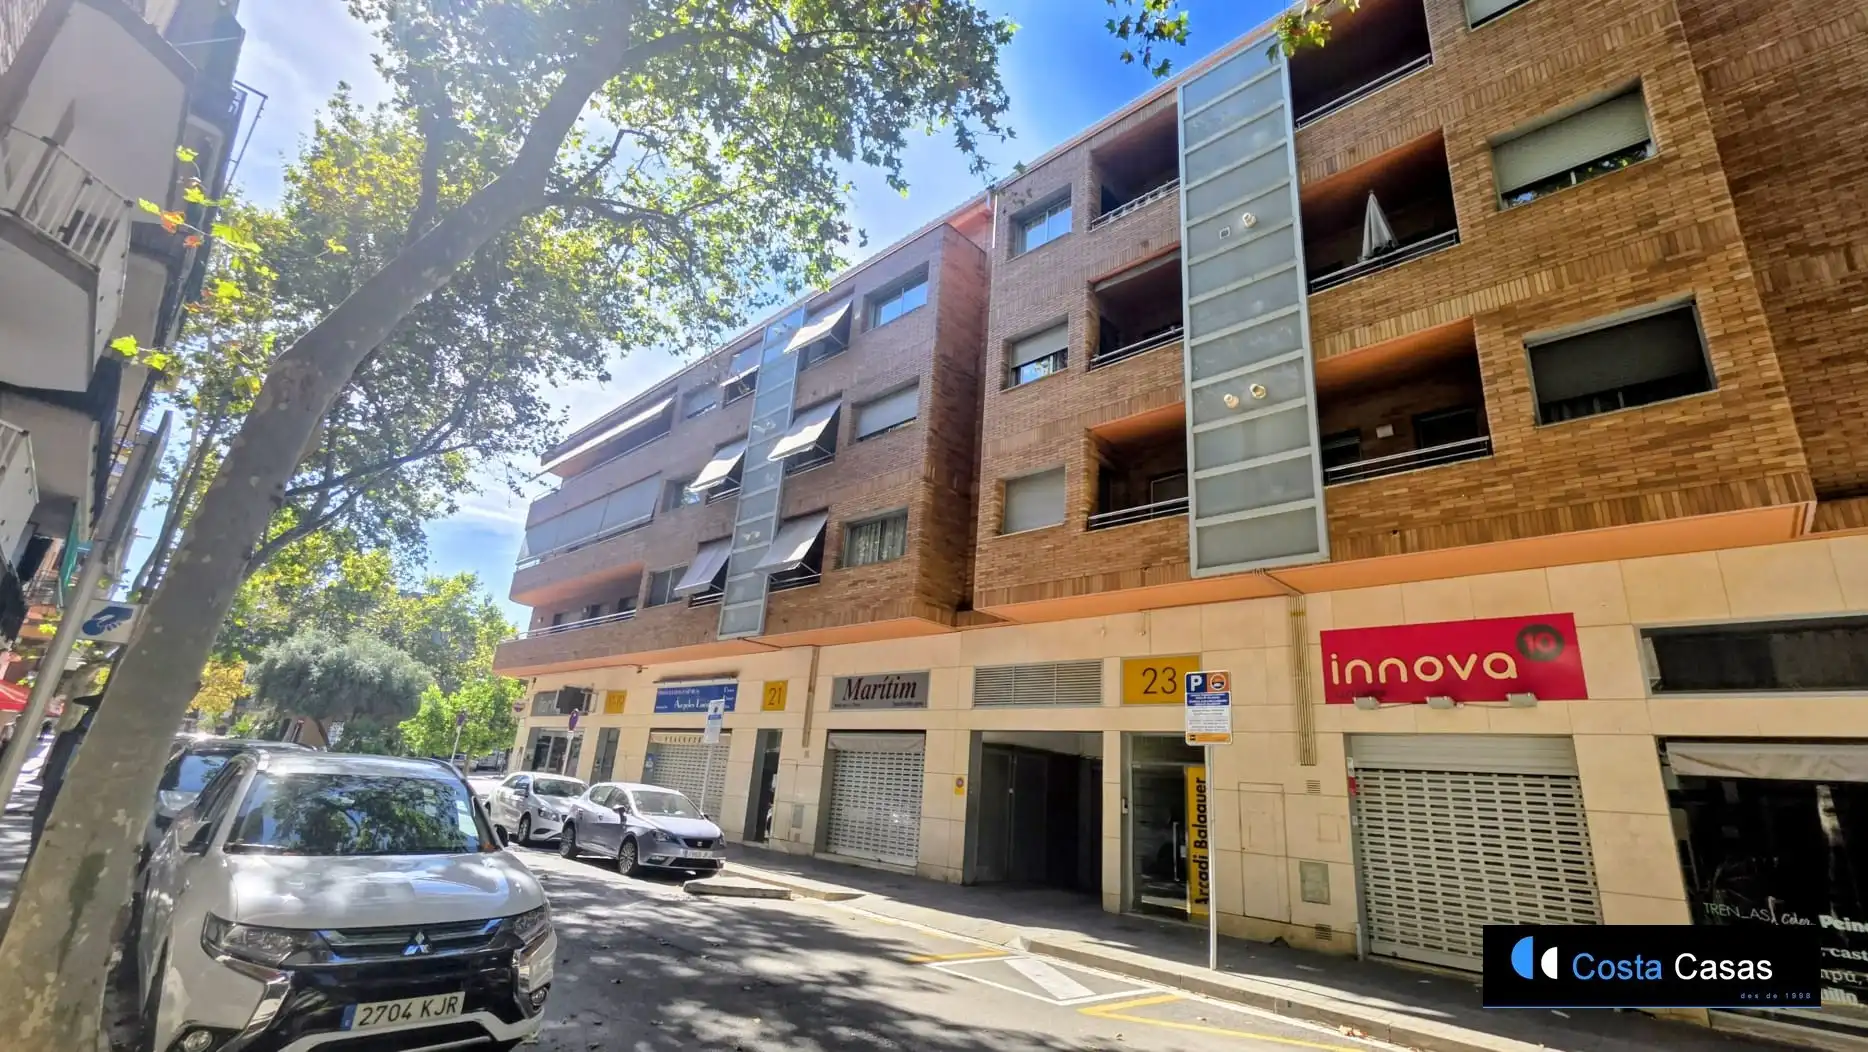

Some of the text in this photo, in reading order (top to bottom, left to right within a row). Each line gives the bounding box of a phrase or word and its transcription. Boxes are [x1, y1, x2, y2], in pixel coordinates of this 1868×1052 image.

[1522, 631, 1557, 655] 10
[1141, 667, 1178, 695] 23
[1330, 652, 1518, 685] innova
[767, 687, 782, 706] 21
[842, 675, 917, 701] Marítim
[1190, 674, 1203, 692] P
[1192, 776, 1208, 850] Balaguer
[358, 996, 458, 1026] 2704 KJR
